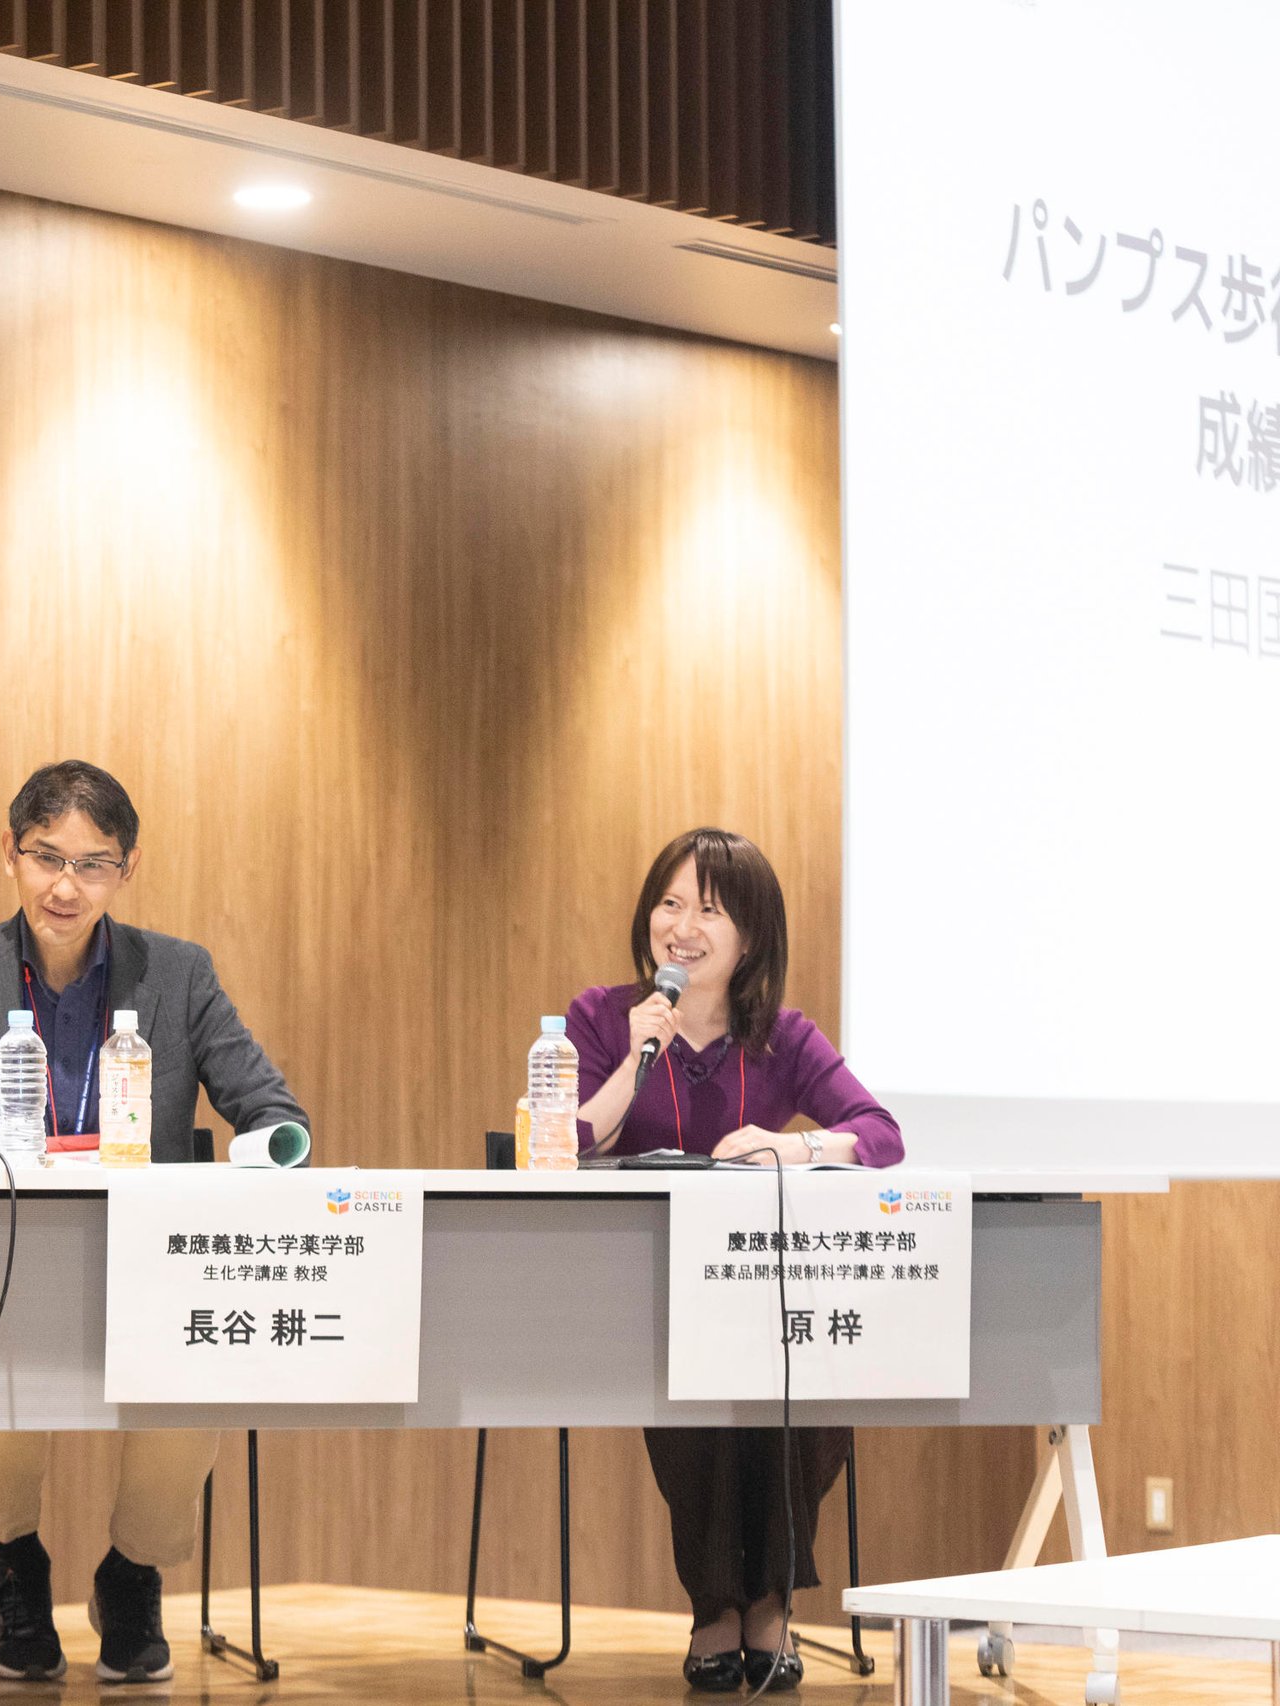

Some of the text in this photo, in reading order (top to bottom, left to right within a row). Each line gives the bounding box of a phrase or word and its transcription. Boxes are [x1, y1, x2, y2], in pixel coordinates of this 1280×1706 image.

[1002, 198, 1280, 357] パンプス歩
[354, 1190, 403, 1201] SCIENCE
[905, 1190, 952, 1201] SCIENCE
[354, 1201, 403, 1213] CASTLE
[905, 1201, 952, 1213] CASTLE
[166, 1233, 365, 1256] 慶應義塾大学薬学部
[202, 1264, 328, 1282] 生化学講座 教授
[891, 1263, 940, 1281] 准教授
[183, 1308, 345, 1347] 長谷 耕二
[781, 1308, 864, 1346] 原 梓
